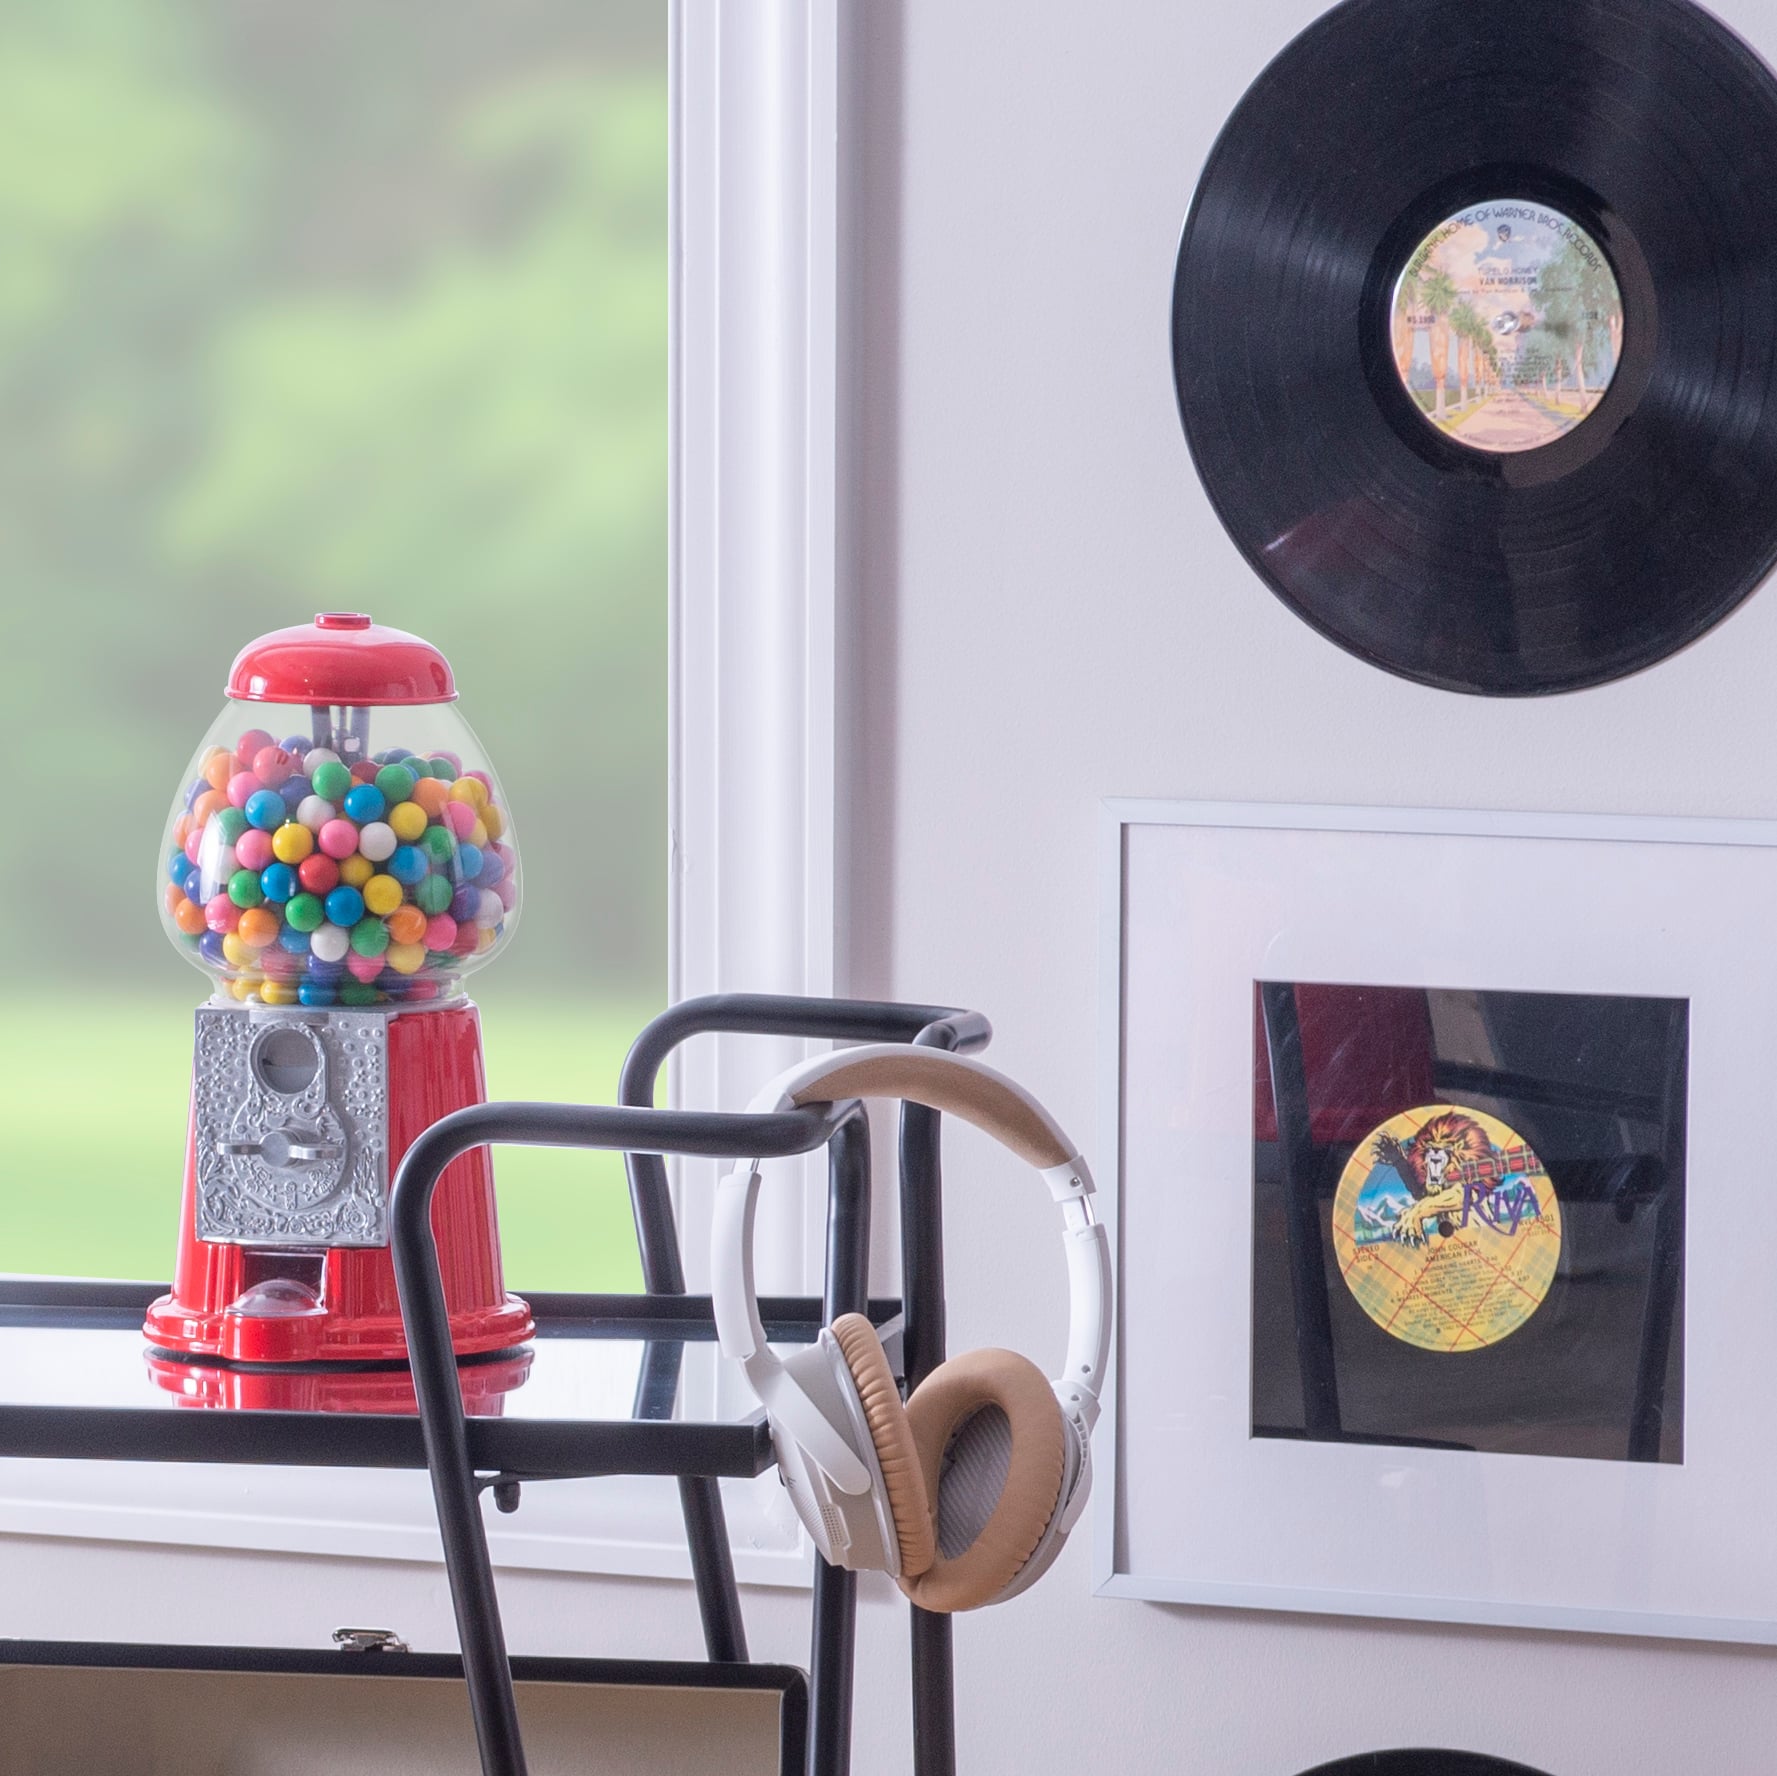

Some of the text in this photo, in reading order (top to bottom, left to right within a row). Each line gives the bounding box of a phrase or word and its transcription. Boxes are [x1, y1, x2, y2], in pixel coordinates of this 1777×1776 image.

[1474, 208, 1491, 222] OF
[1492, 207, 1536, 221] WARNER
[1563, 227, 1602, 272] RECORDS
[1459, 1181, 1542, 1237] RIVA
[1425, 1251, 1463, 1263] AMERICAN
